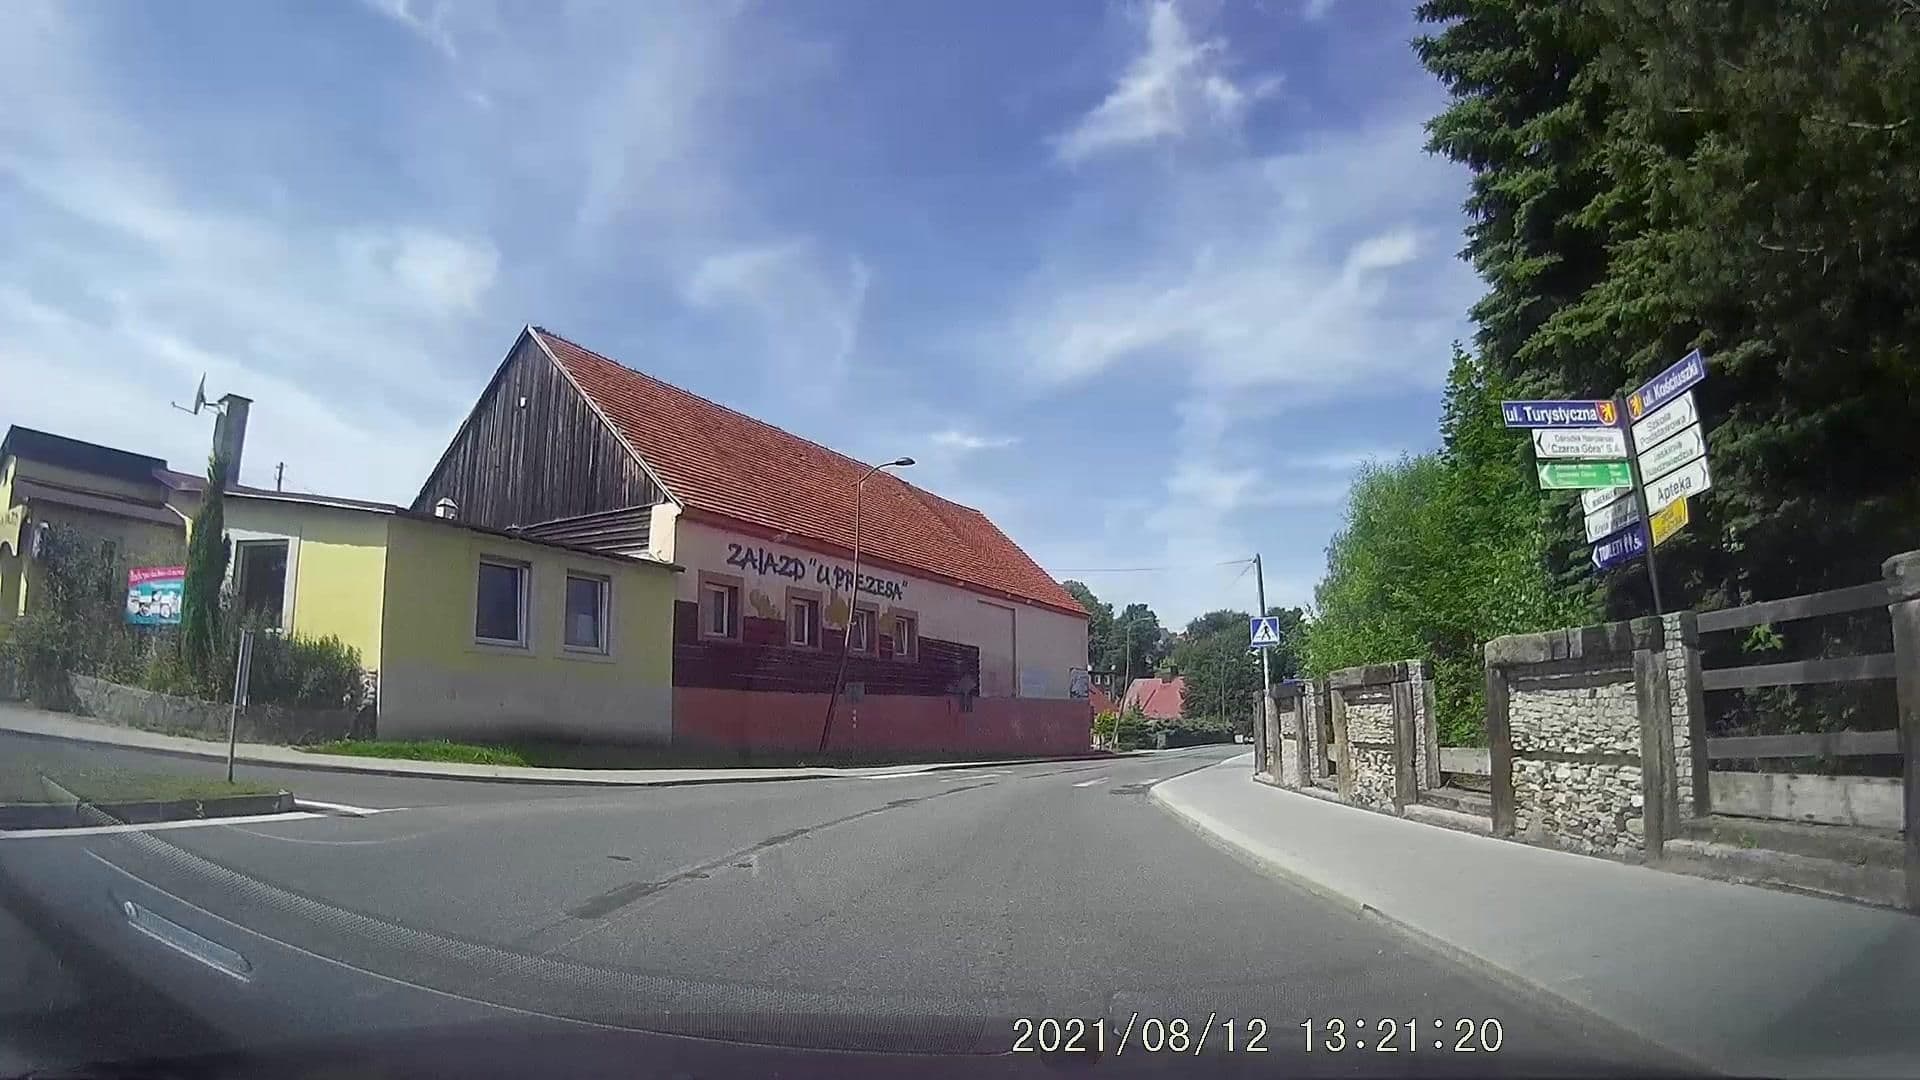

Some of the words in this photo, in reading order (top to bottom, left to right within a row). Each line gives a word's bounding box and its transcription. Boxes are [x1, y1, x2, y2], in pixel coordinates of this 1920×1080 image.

[1653, 359, 1699, 400] Kościuszki
[1505, 406, 1522, 422] ul.
[1523, 406, 1598, 425] Turystyczna
[1657, 475, 1693, 502] Apteka
[726, 543, 806, 582] ZAJAZD
